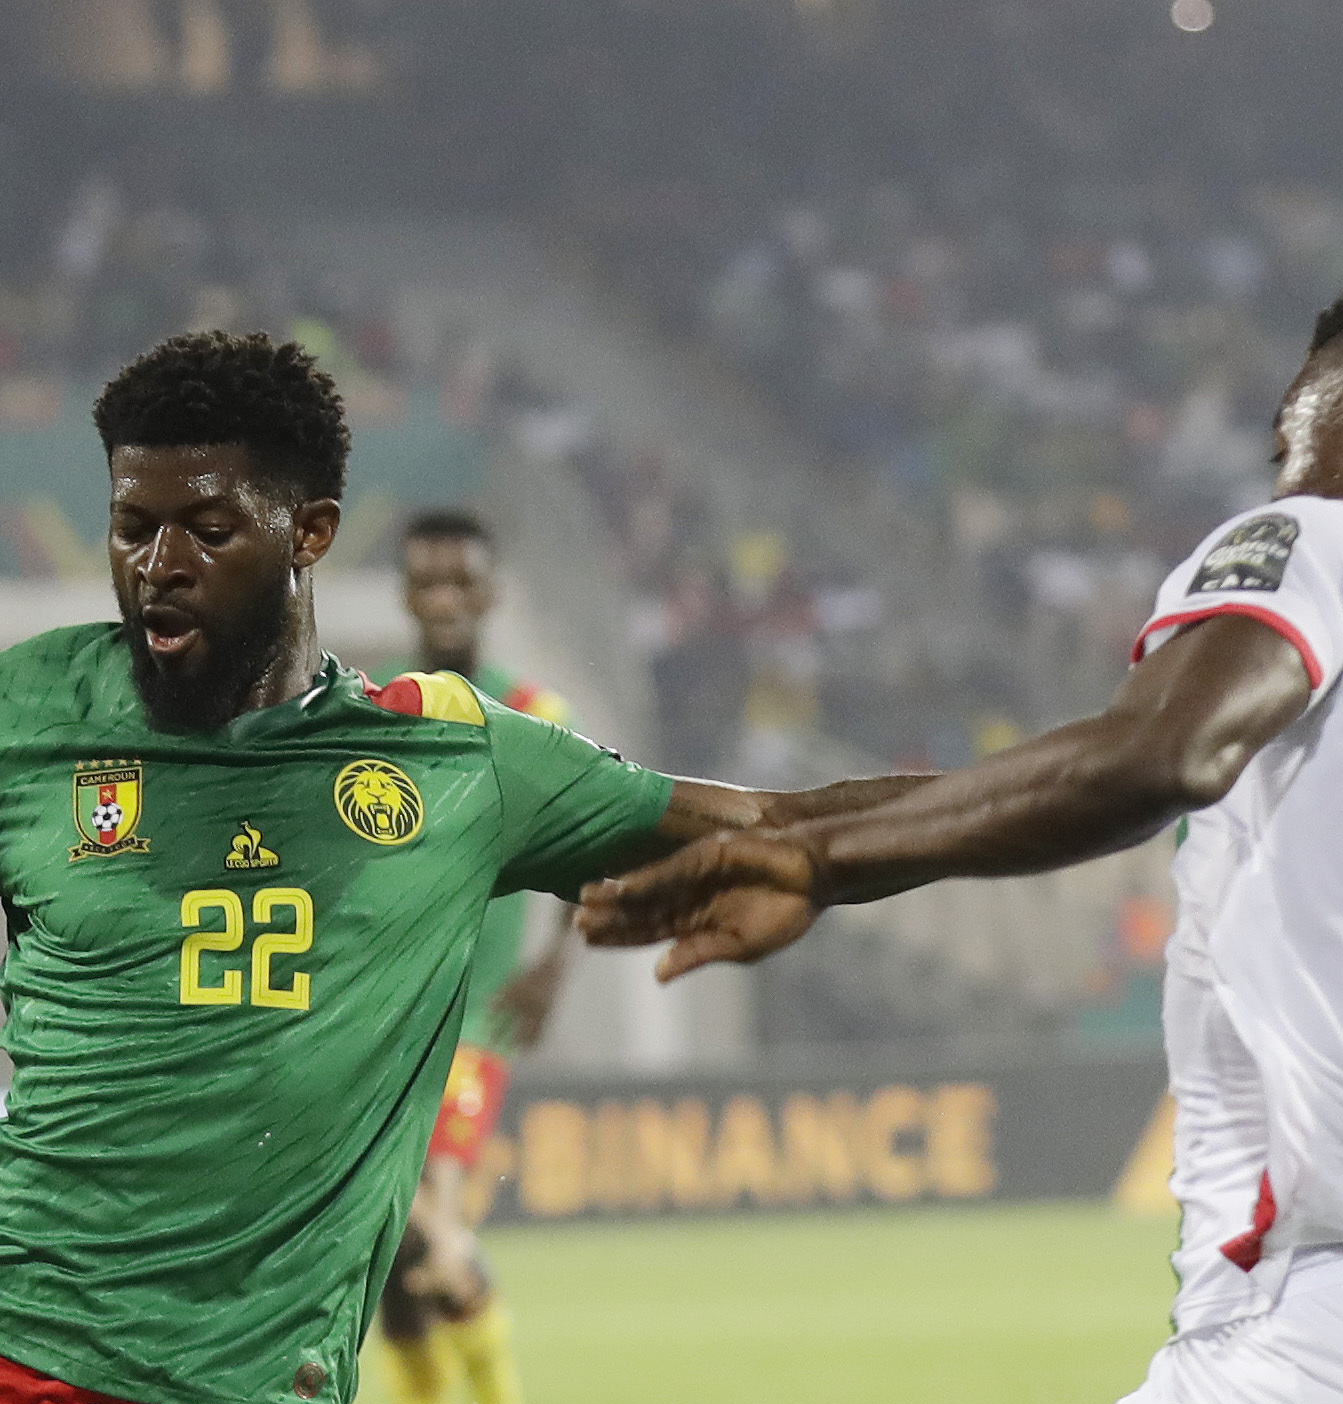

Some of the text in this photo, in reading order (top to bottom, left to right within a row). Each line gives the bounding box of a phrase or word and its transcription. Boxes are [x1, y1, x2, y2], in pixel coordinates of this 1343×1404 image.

[80, 771, 136, 785] CAMEROUN
[180, 888, 314, 1010] 22
[520, 1083, 998, 1215] BINANCE
